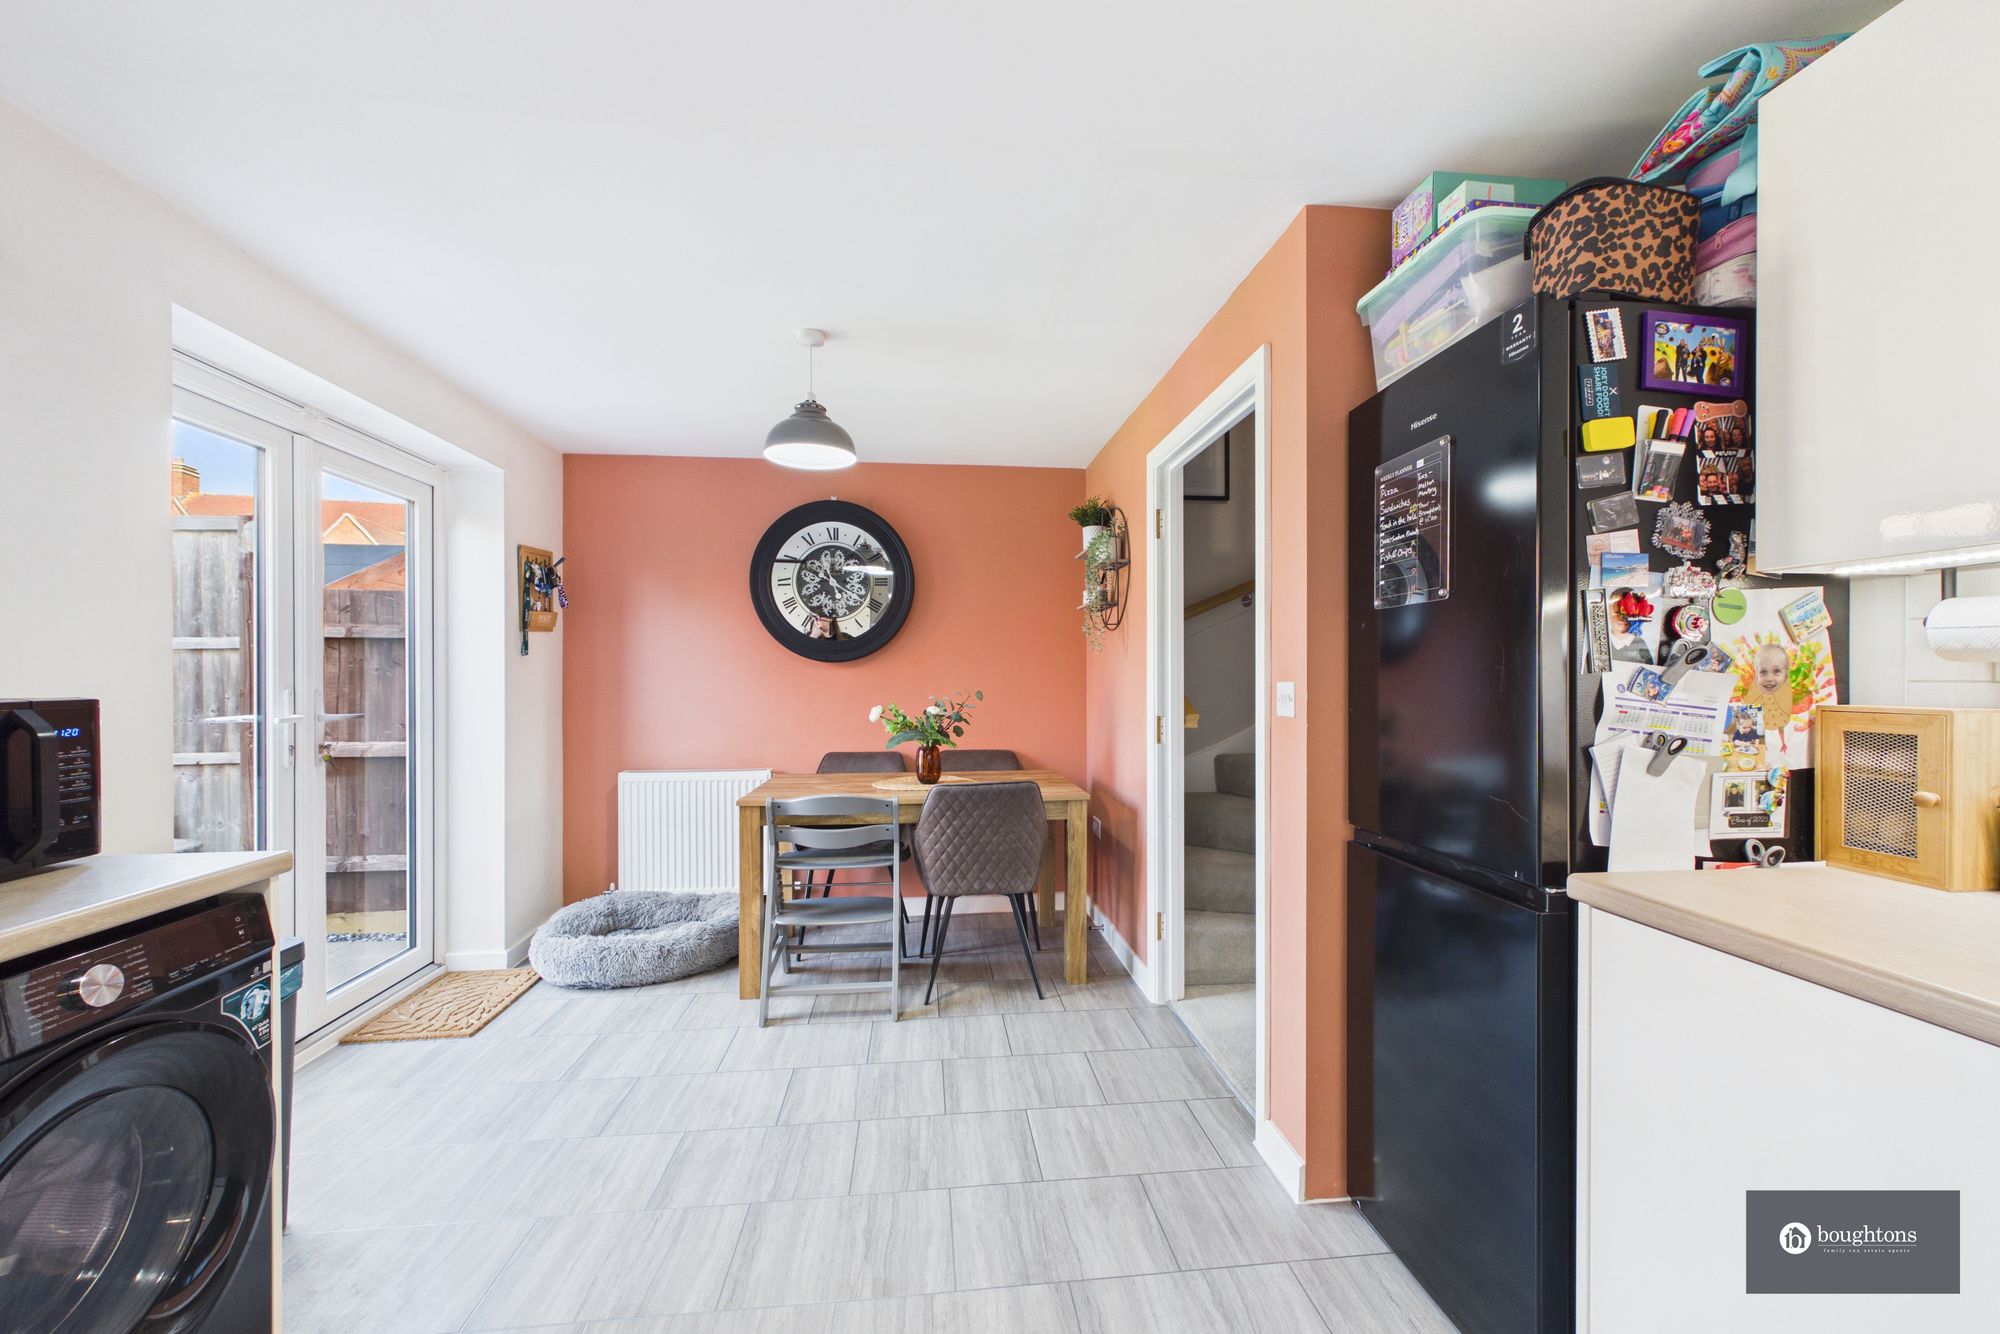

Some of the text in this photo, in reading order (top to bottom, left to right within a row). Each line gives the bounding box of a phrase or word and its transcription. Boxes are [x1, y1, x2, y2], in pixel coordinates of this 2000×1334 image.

[1512, 313, 1523, 334] 2
[1510, 330, 1526, 340] YEAR
[1506, 334, 1532, 351] WARRANTY
[1410, 412, 1438, 430] Hisense
[1381, 488, 1398, 498] Pizza
[1380, 499, 1410, 515] Sandwiches
[1380, 520, 1392, 530] Toad
[1380, 552, 1392, 563] Fish
